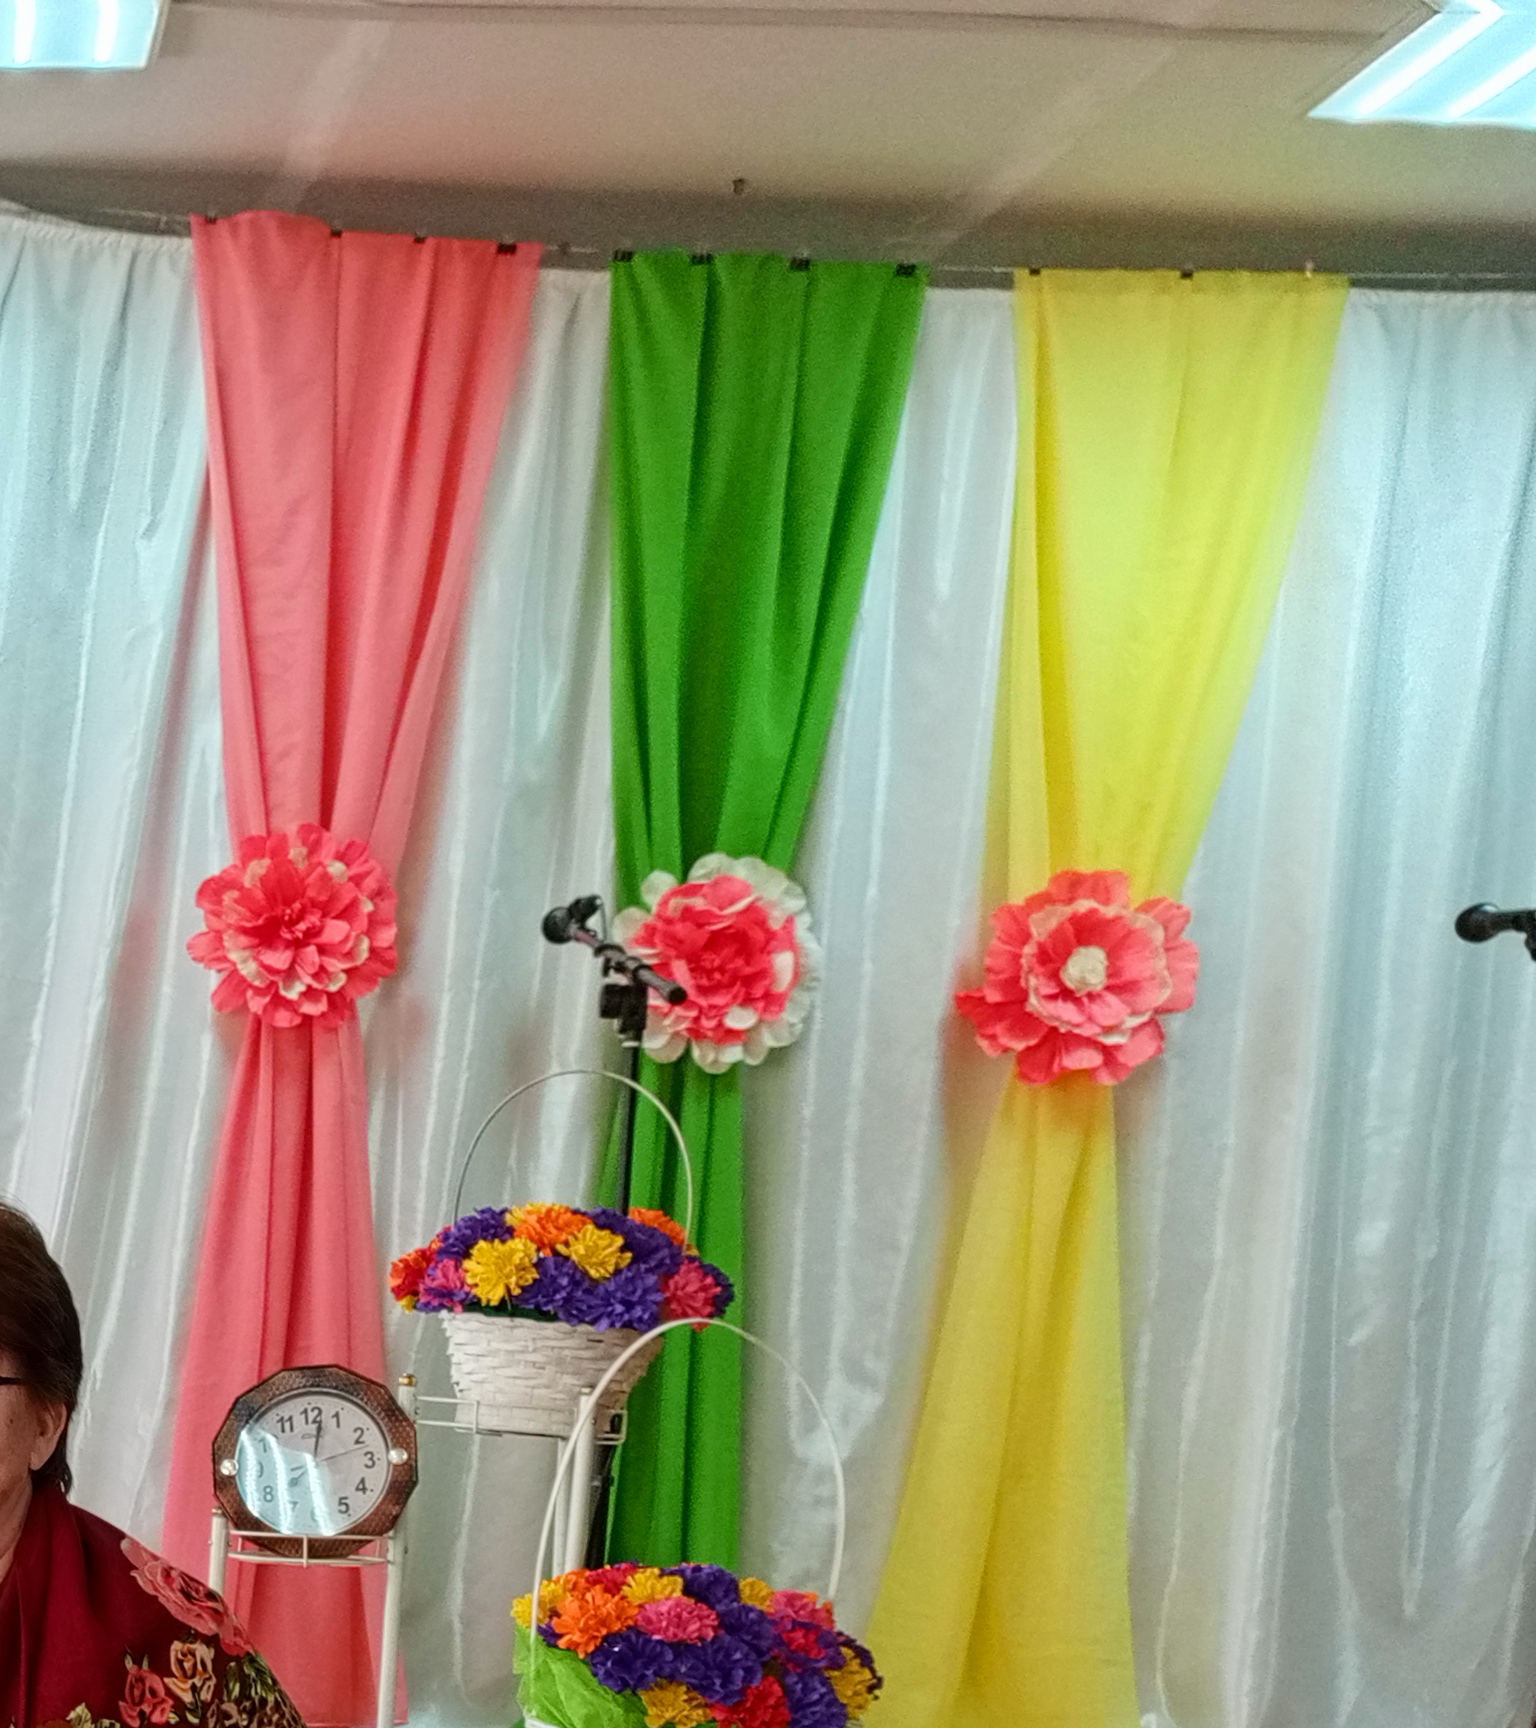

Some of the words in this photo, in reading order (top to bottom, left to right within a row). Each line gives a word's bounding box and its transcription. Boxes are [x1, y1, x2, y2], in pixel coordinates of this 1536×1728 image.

[276, 1415, 294, 1433] 11
[300, 1406, 323, 1425] 12
[331, 1411, 341, 1429] 1
[353, 1427, 365, 1445] 2
[364, 1451, 376, 1469] 3
[263, 1485, 274, 1503] 8
[355, 1477, 368, 1495] 4
[338, 1497, 350, 1514] 5
